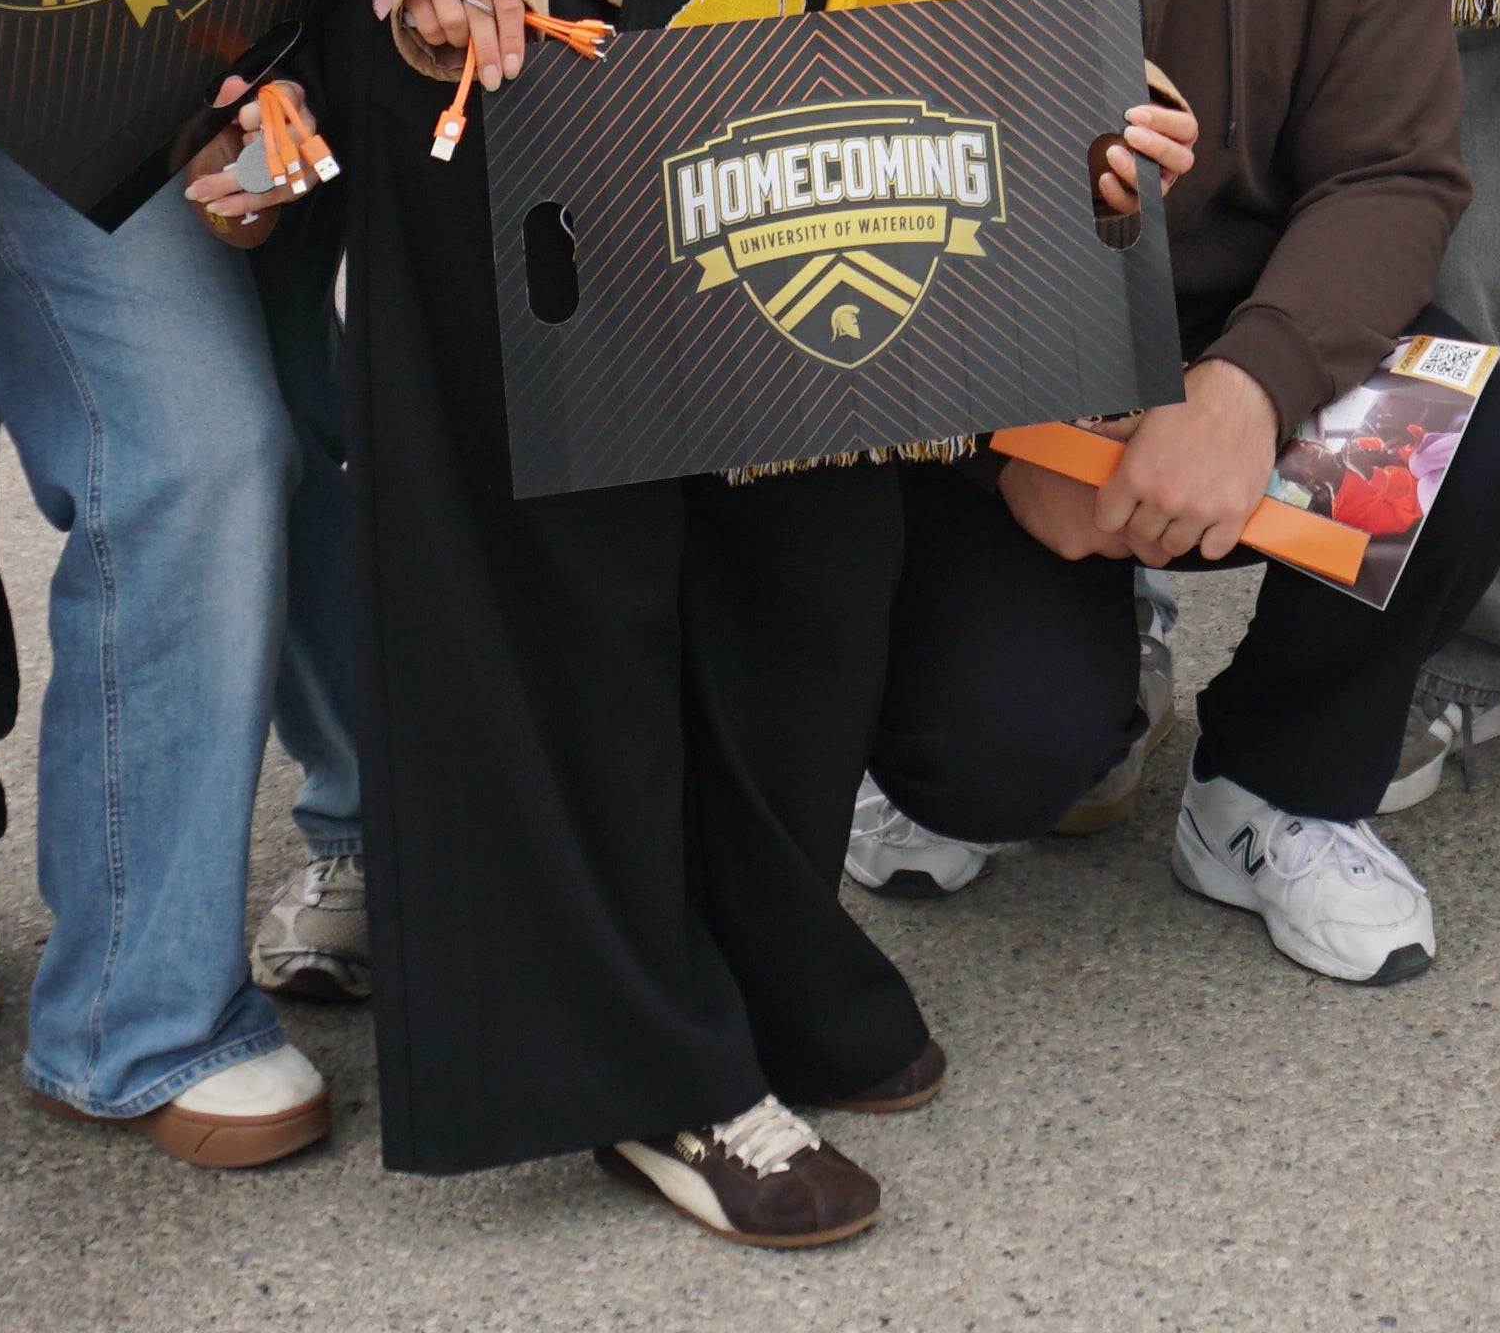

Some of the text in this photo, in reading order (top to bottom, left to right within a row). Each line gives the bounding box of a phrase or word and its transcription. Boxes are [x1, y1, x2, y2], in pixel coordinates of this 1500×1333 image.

[677, 130, 992, 246] HOMECOMING
[739, 214, 936, 255] UNIVERSITY OF WATERLOO
